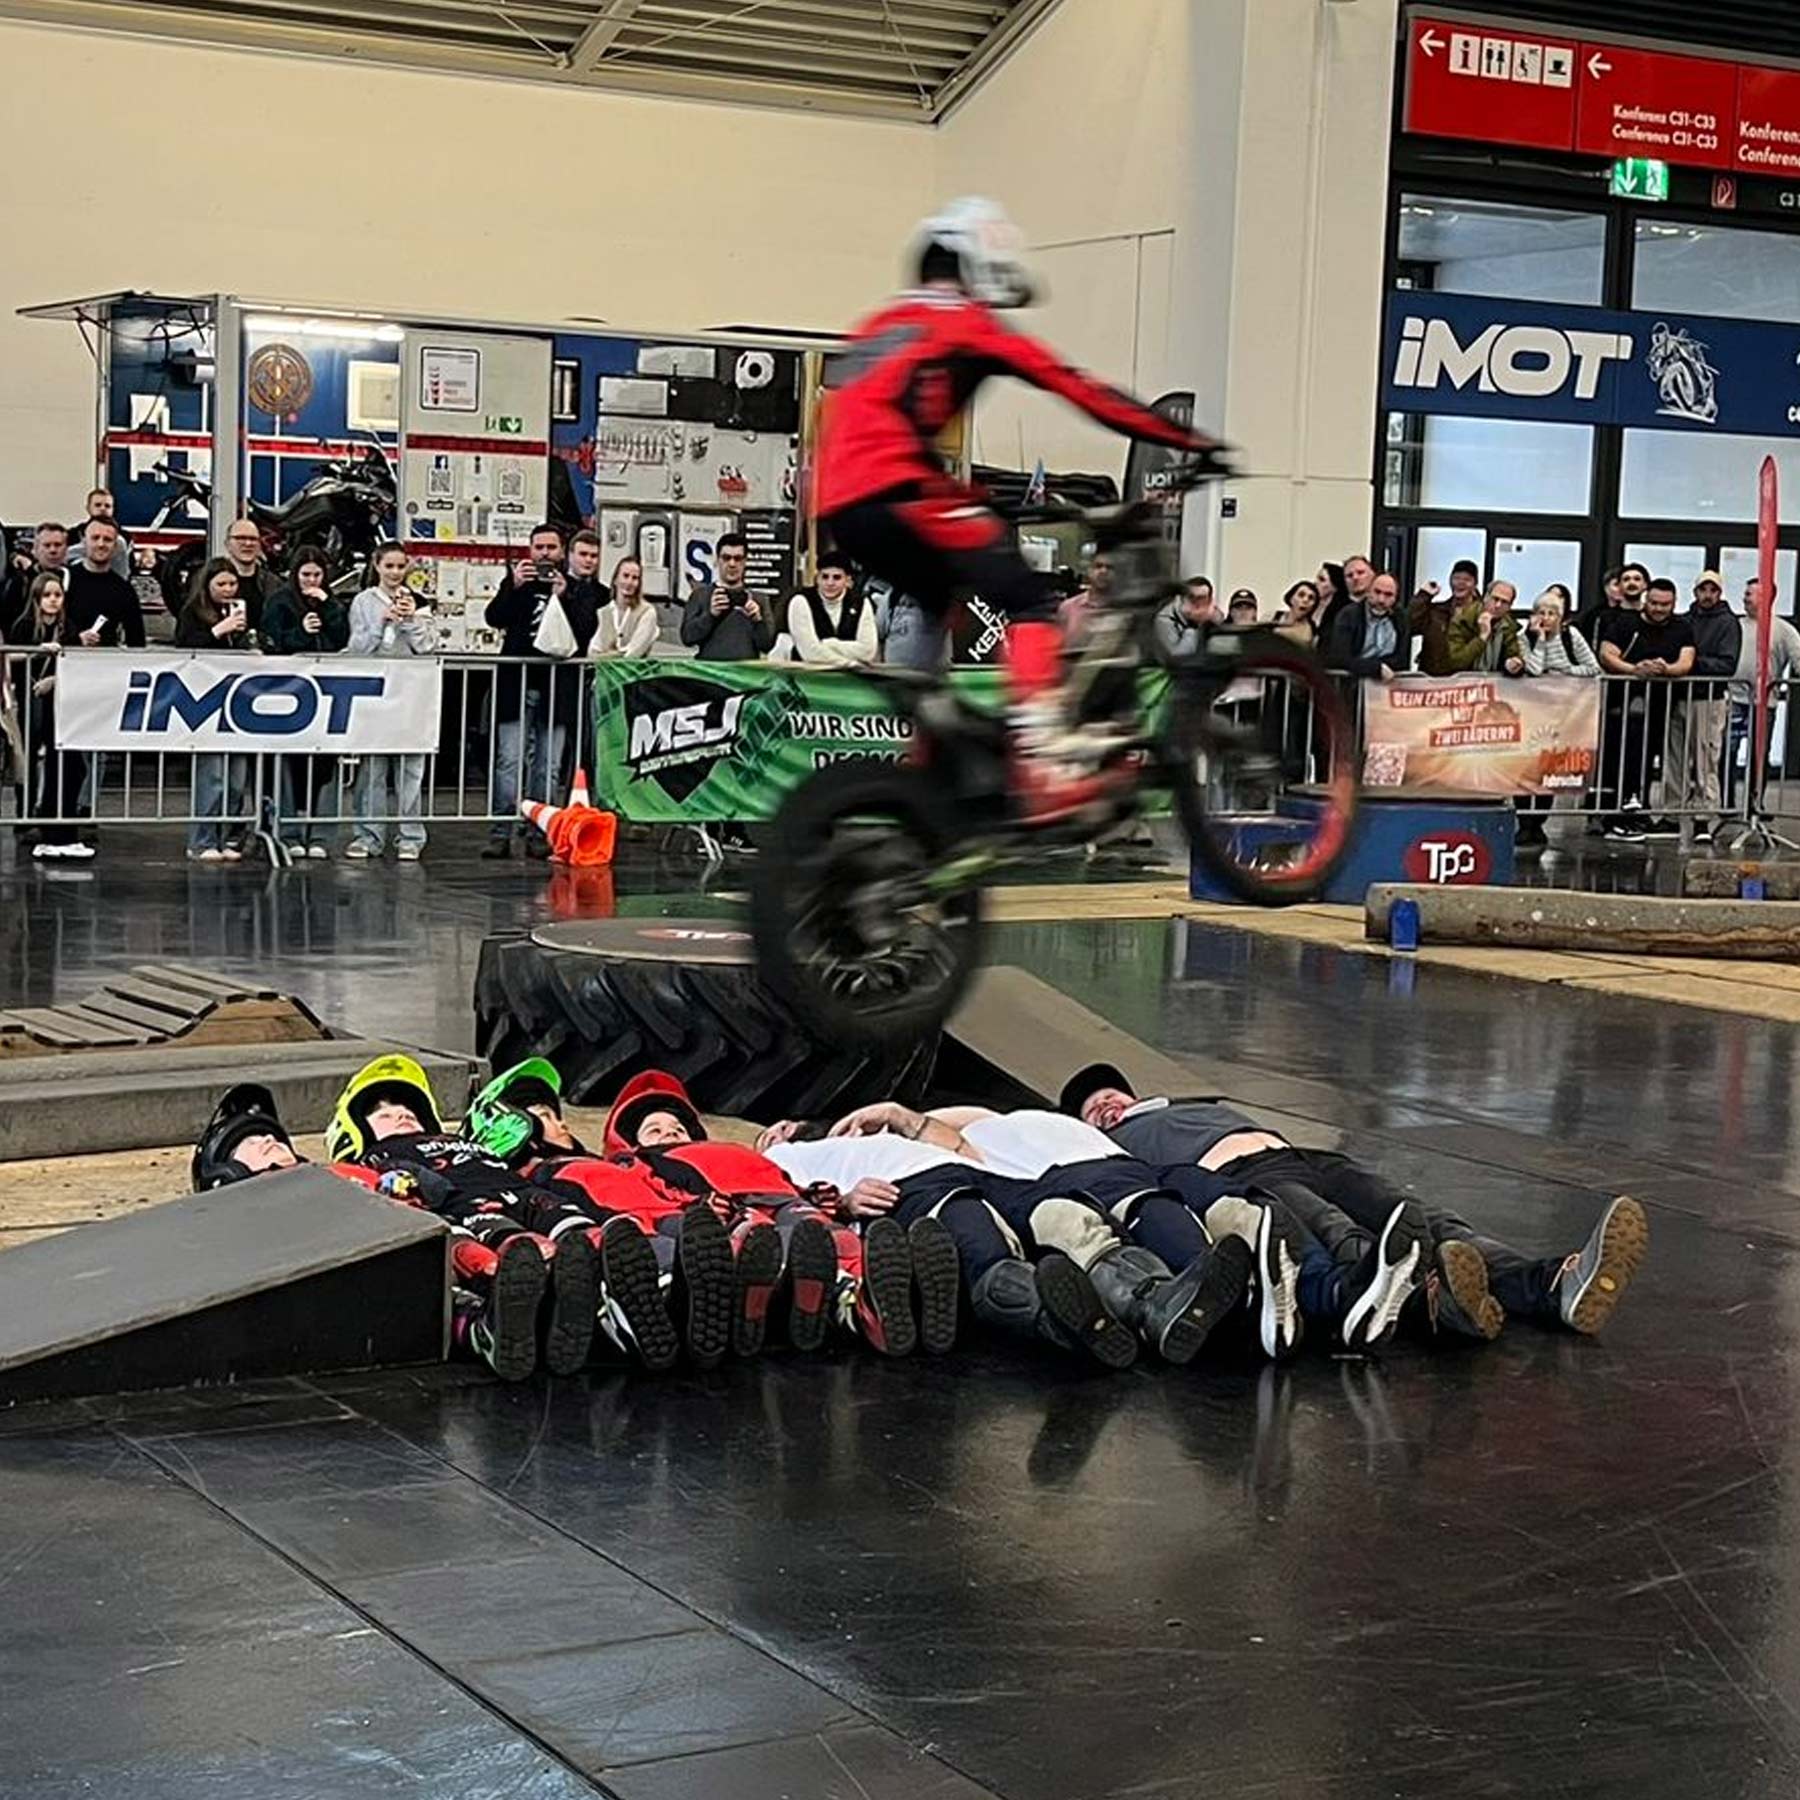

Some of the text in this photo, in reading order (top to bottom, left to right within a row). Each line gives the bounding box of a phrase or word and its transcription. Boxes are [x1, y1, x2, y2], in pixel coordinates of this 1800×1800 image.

[1612, 123, 1719, 150] Conference C31-C33
[1669, 111, 1716, 130] C31-C33
[1393, 317, 1633, 399] iMOT
[120, 671, 385, 735] iMOT
[630, 695, 746, 760] MSJ
[787, 713, 914, 739] WIR SIND
